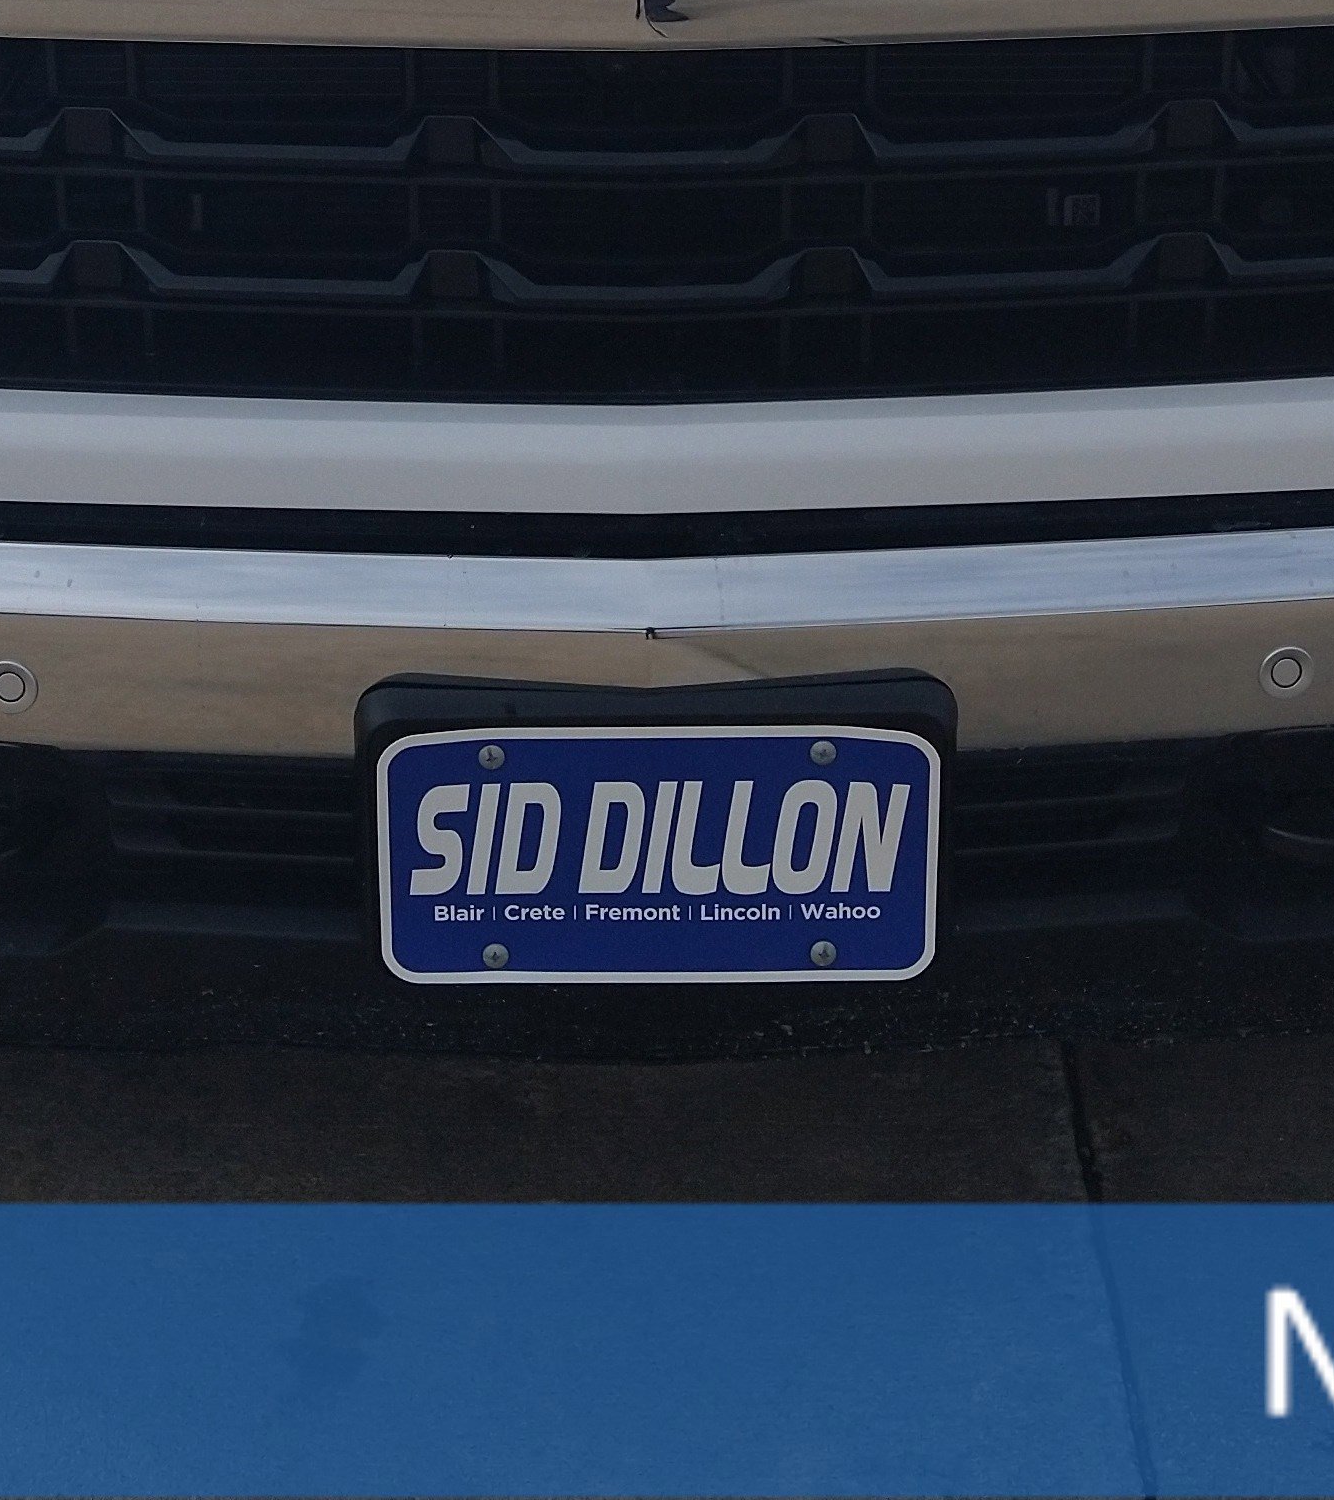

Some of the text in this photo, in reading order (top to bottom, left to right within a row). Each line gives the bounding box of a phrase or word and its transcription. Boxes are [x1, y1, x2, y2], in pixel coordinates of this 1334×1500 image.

[409, 779, 911, 896] SID DILLON
[434, 902, 881, 921] Blair Crete Fremont Lincoln Wahoo
